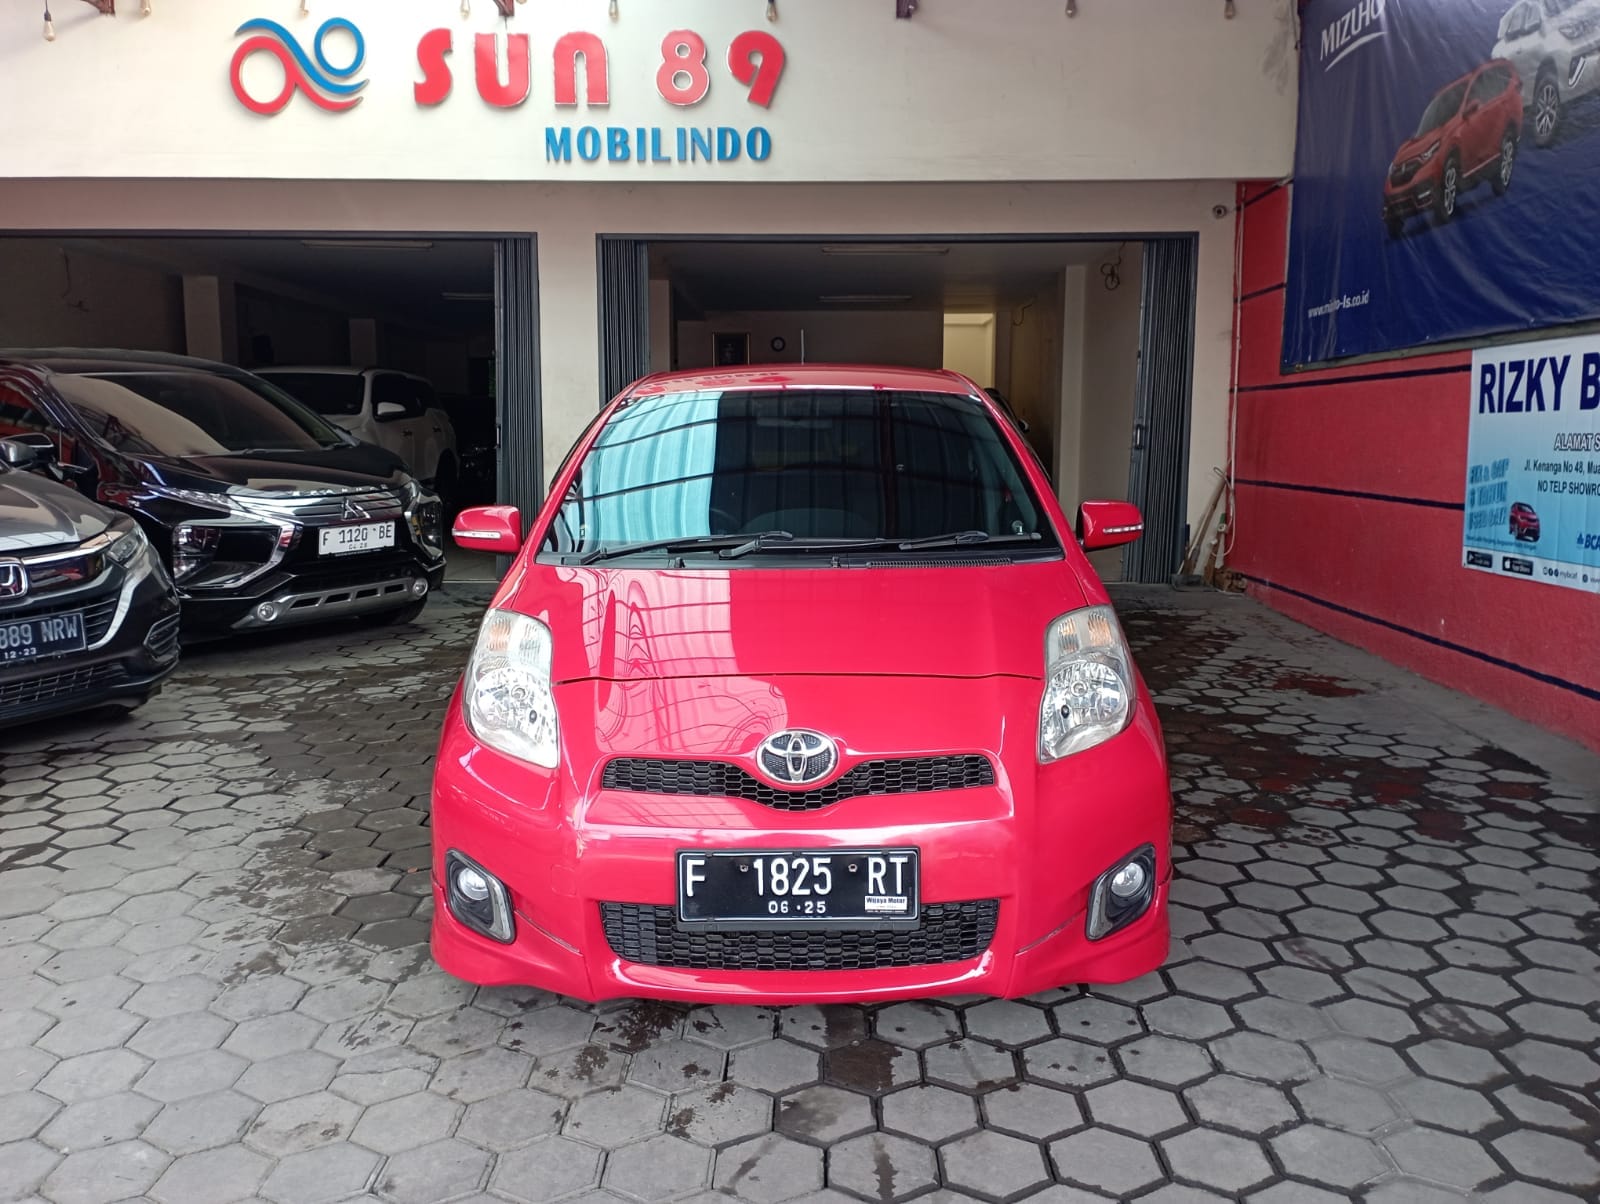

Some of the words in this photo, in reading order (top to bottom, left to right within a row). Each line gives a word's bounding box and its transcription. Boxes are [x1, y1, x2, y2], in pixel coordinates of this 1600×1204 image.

[656, 29, 786, 110] 89
[545, 126, 771, 163] MOBILINDO
[1479, 355, 1571, 415] RIZKY
[1554, 433, 1593, 452] ALAMAT
[1533, 459, 1562, 475] Kenanga
[1563, 460, 1573, 473] No
[1537, 480, 1548, 492] NO
[1549, 480, 1567, 493] TELP
[322, 531, 330, 546] F
[339, 528, 368, 543] 1120
[379, 525, 392, 539] BE
[41, 615, 77, 642] NRW
[686, 859, 705, 896] F
[753, 858, 832, 896] 1825
[867, 857, 908, 894] RT
